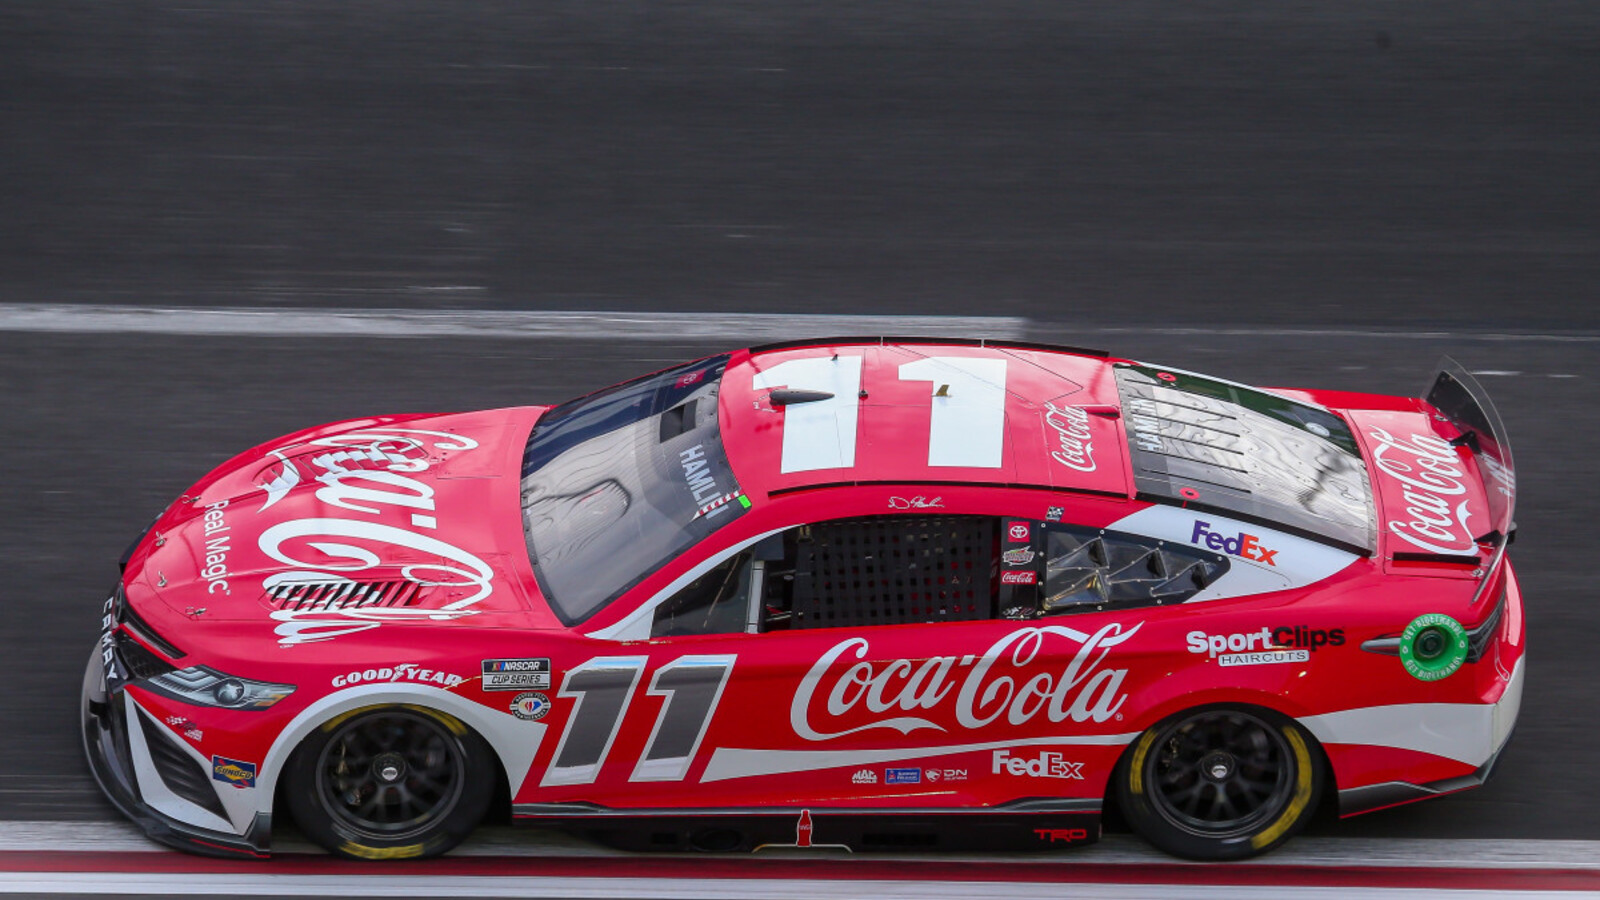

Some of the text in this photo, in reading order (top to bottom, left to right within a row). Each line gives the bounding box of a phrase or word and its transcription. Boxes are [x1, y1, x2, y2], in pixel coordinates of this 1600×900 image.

[753, 355, 1007, 474] 11
[201, 499, 234, 593] Real Magic
[1191, 520, 1279, 567] FedEx
[101, 597, 118, 679] CAMRY
[1186, 625, 1346, 658] SportClips
[1221, 651, 1306, 665] HAIRCUTS
[491, 674, 541, 685] CUP SERIES
[502, 661, 540, 671] NASCAR
[791, 619, 1145, 742] Coca-Cola
[540, 654, 737, 787] 11
[215, 765, 254, 780] SUNOCO
[992, 750, 1085, 780] FedEx
